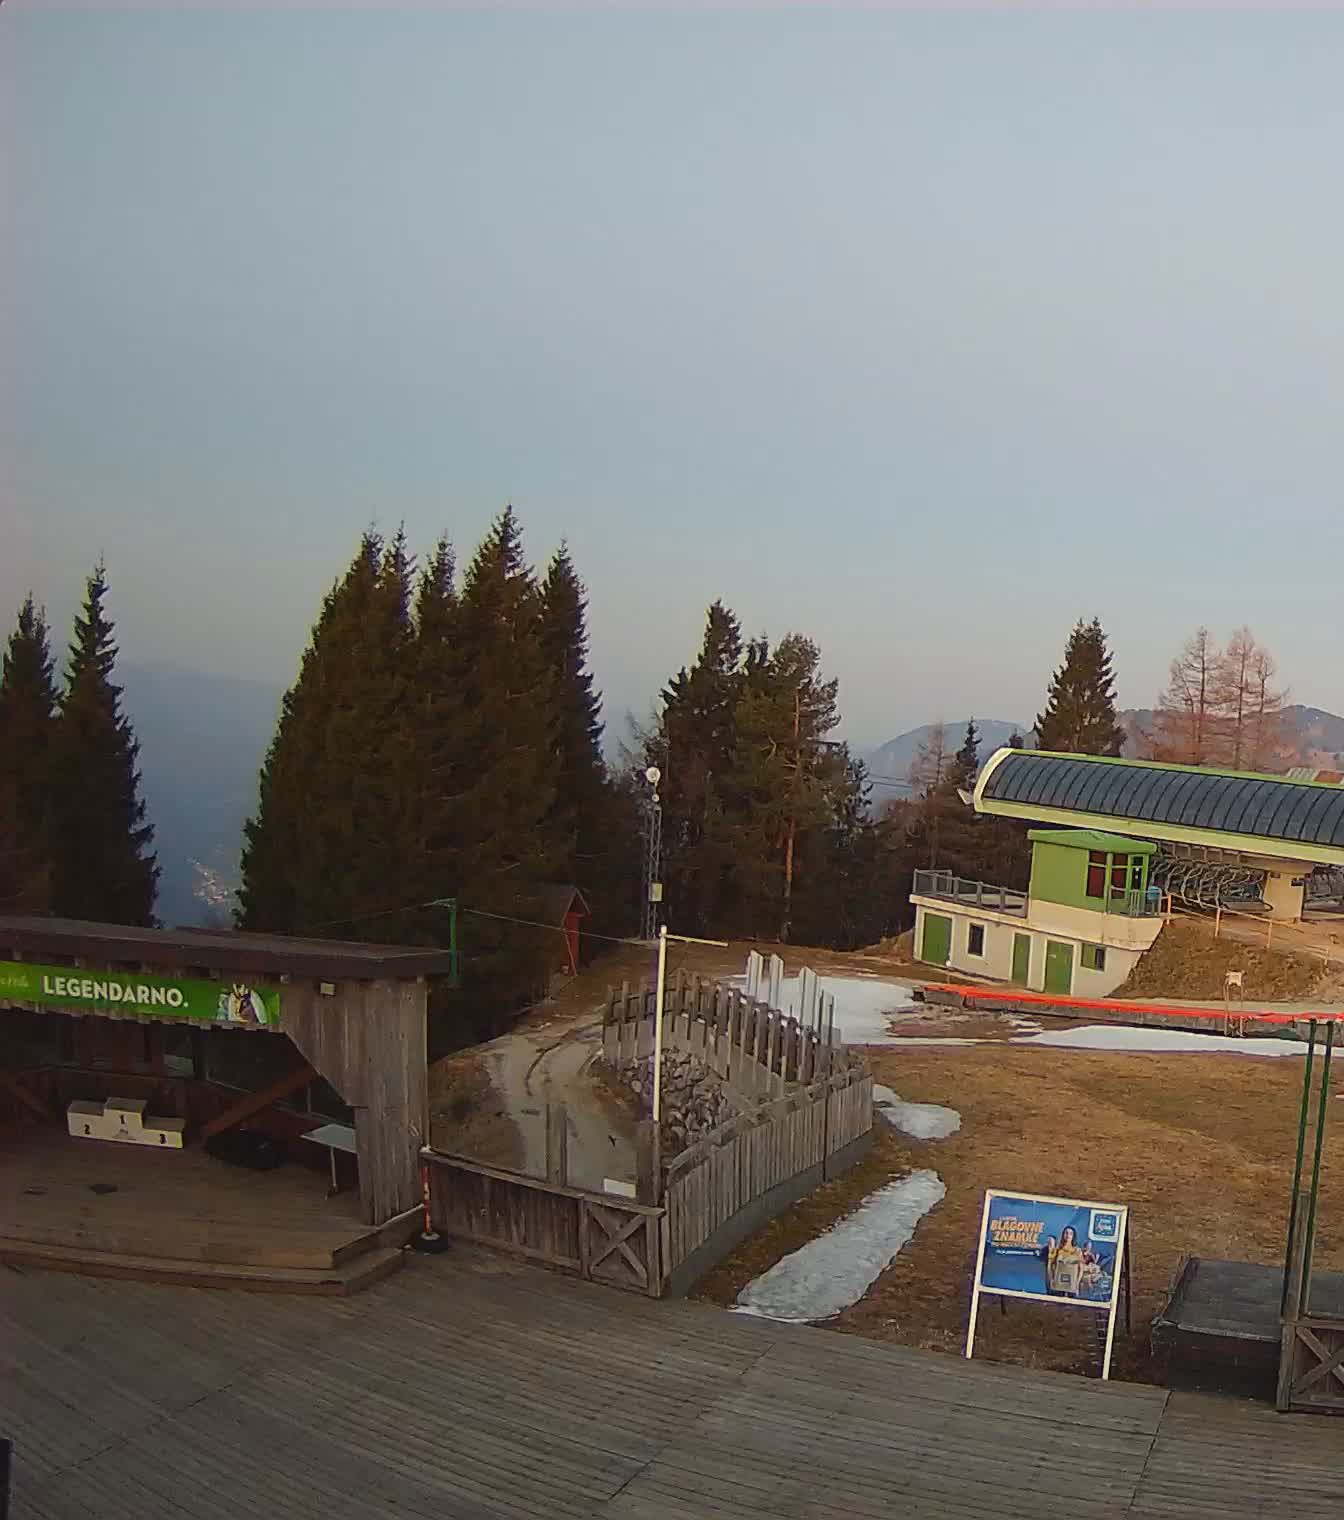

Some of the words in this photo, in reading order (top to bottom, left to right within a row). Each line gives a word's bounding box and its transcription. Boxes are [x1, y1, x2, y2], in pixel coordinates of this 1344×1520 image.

[43, 975, 188, 1007] LEGENDARNO.
[120, 1114, 125, 1124] 1
[84, 1124, 90, 1134] 2
[160, 1133, 167, 1144] 3
